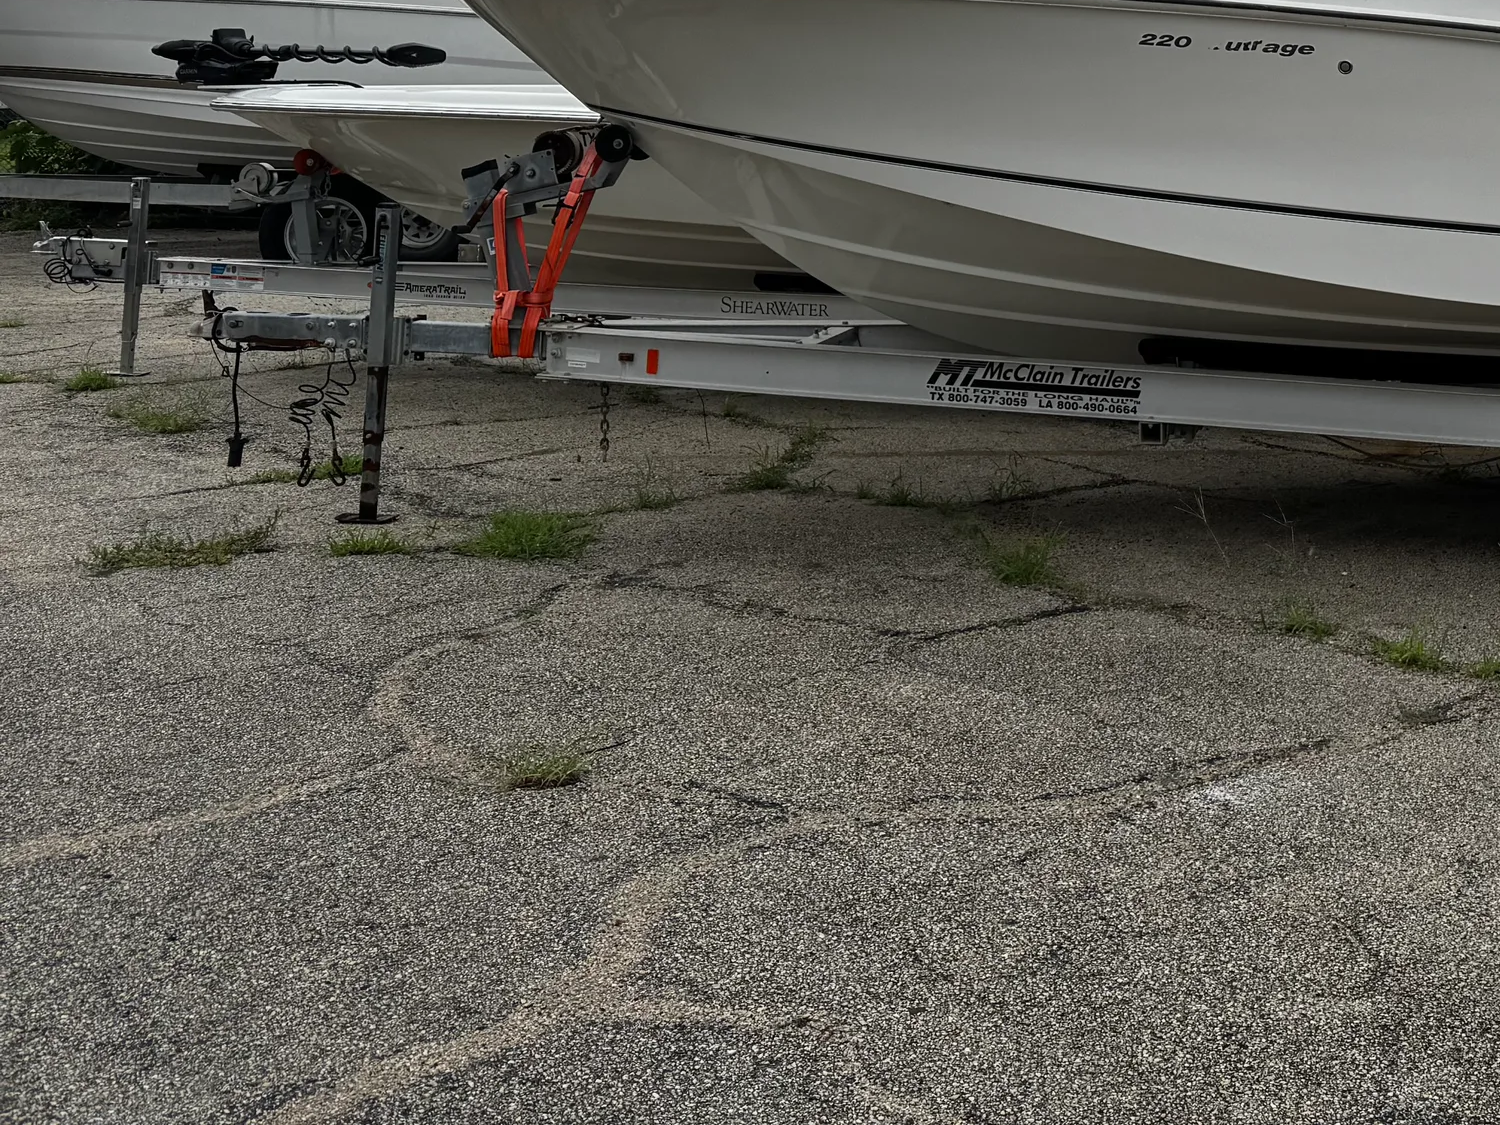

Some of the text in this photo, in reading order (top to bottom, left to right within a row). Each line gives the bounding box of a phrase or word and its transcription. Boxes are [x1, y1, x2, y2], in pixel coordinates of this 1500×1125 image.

[1138, 33, 1192, 48] 220
[720, 296, 829, 317] SHEARWATER
[981, 361, 1065, 385] McClain
[1070, 367, 1142, 390] Trailers
[929, 391, 1138, 415] TX 800-747-3059 LA 800-490-0664
[972, 388, 1001, 396] FOR
[1003, 390, 1029, 398] THE
[1034, 392, 1084, 402] LONG
